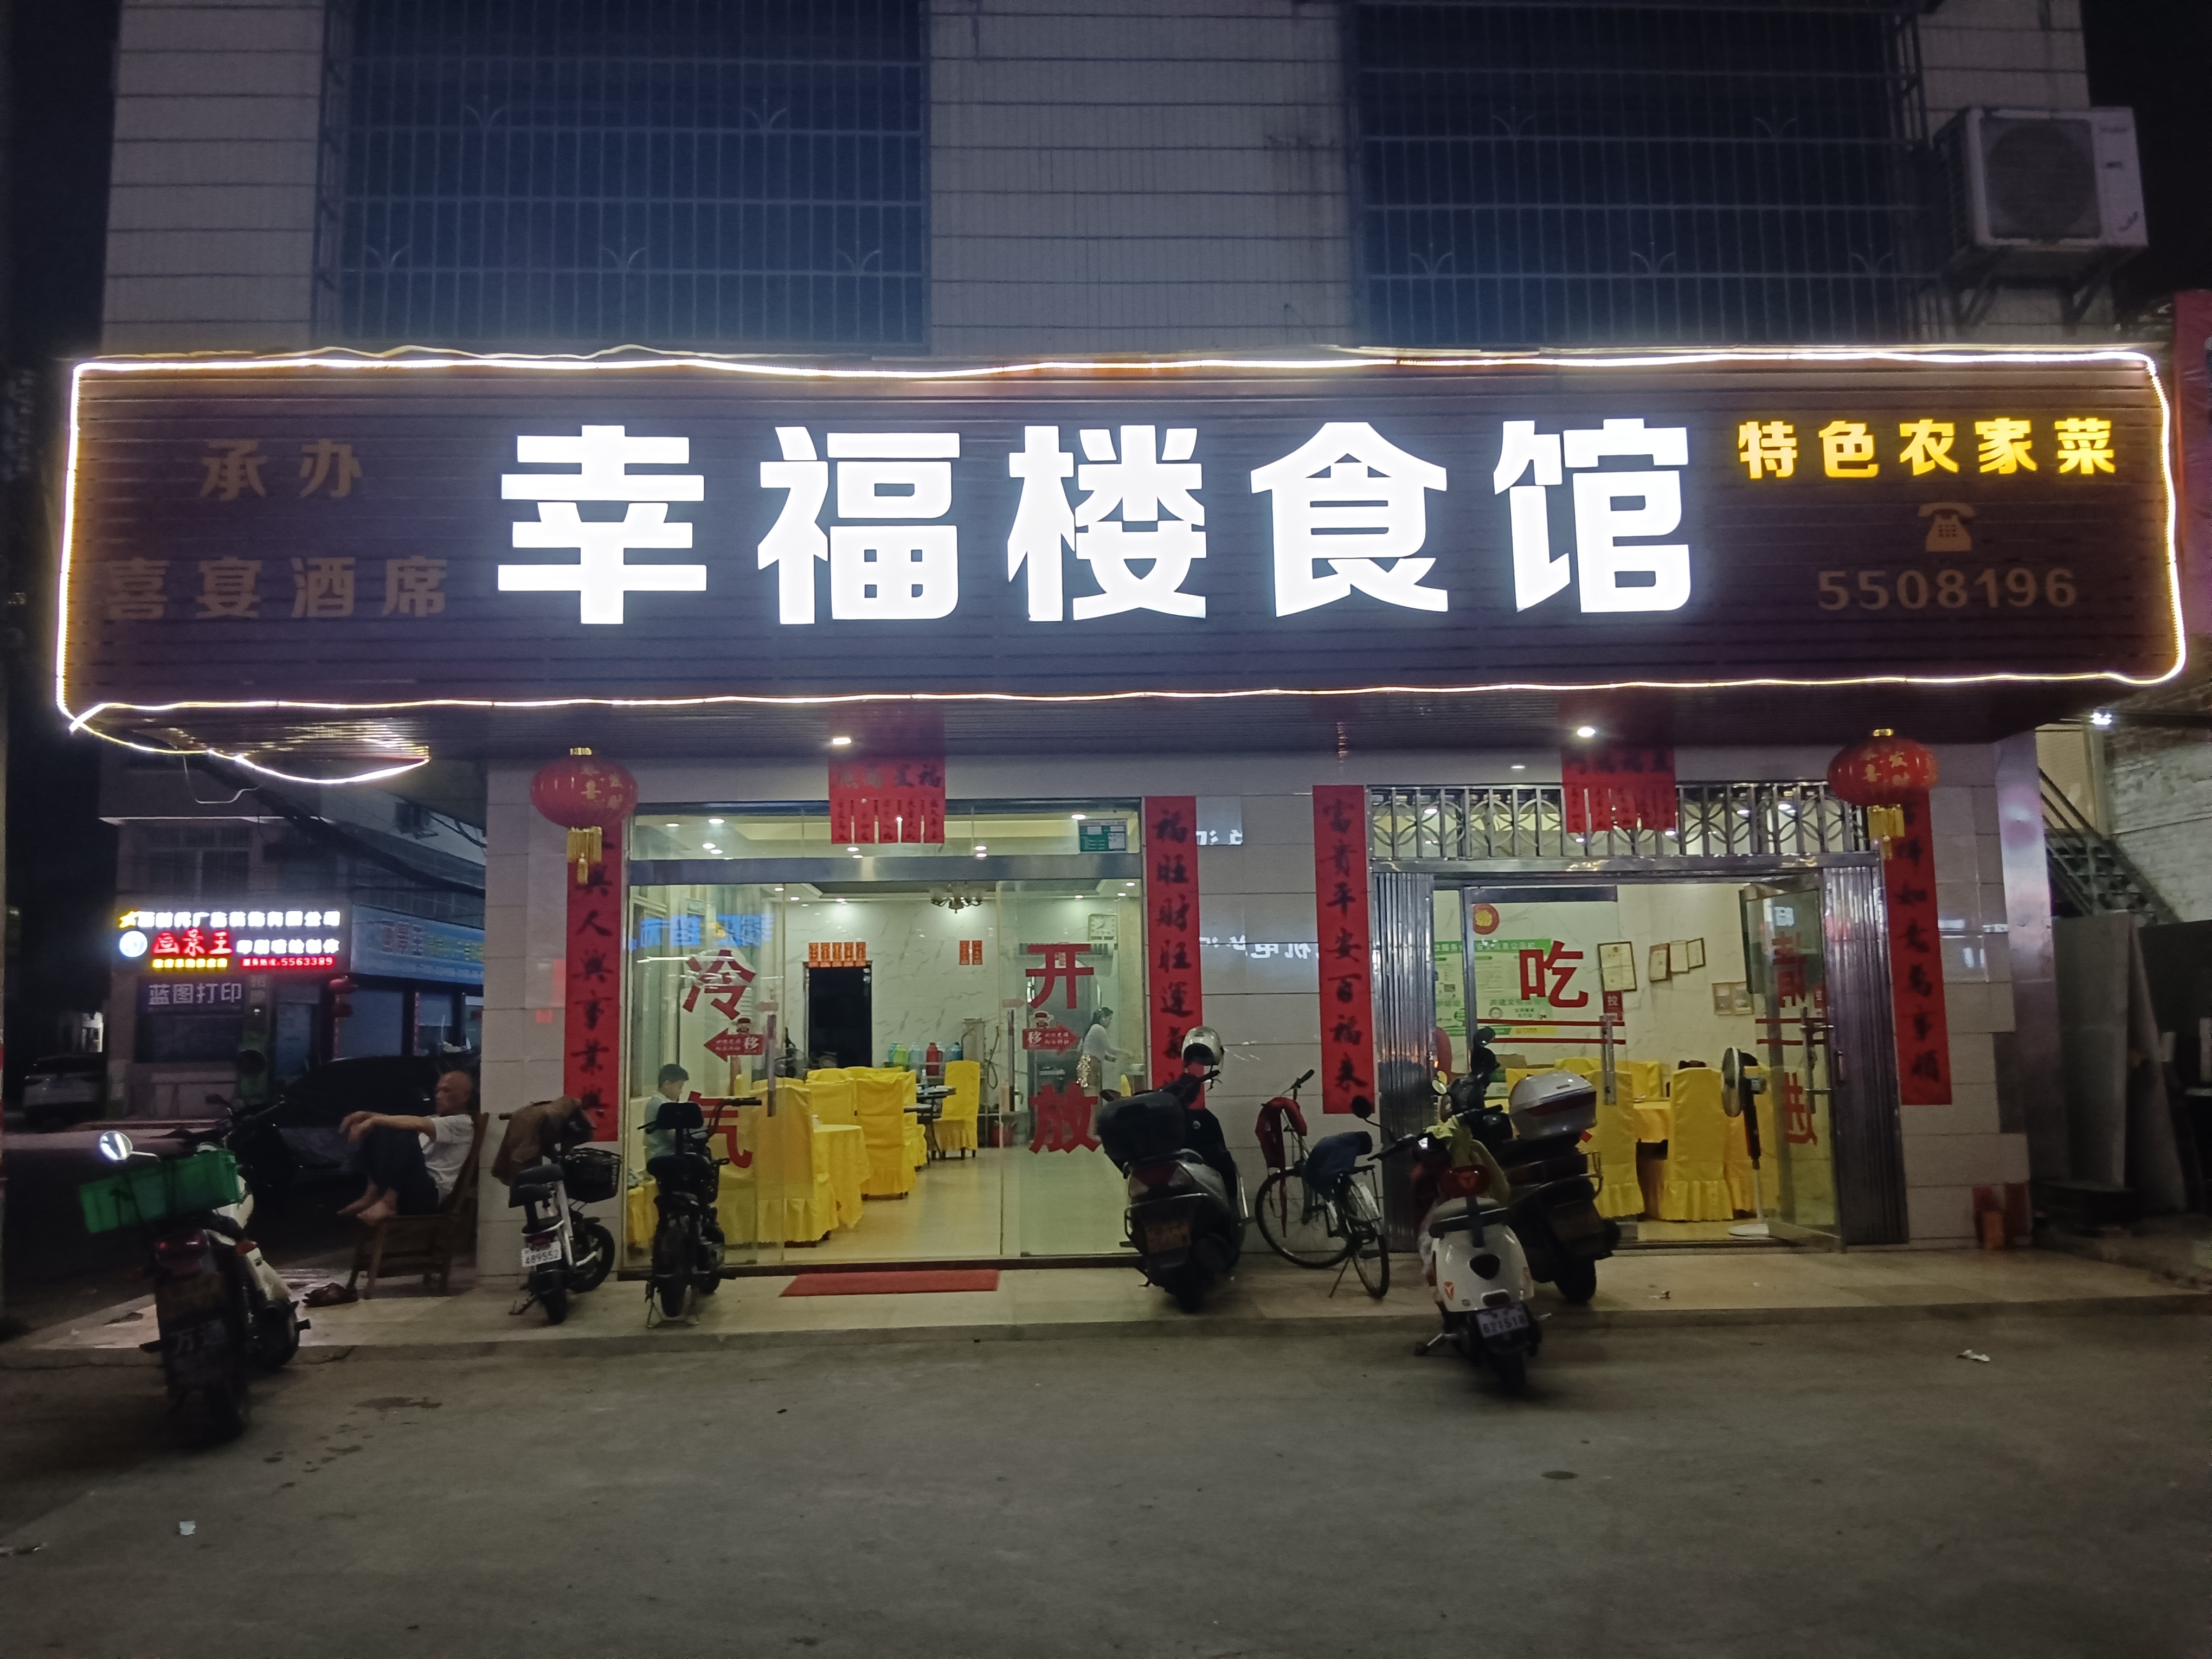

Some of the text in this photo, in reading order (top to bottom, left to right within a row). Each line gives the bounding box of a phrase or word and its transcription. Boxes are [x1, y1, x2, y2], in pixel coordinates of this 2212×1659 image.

[200, 439, 362, 501] 承办
[1738, 418, 2115, 479] 特色农家菜
[498, 419, 1691, 625] 幸福楼食馆
[107, 555, 447, 619] 喜宴酒席
[1818, 567, 2078, 610] 5508196
[149, 982, 242, 1005] 蓝图打印
[1519, 940, 1589, 1008] 吃
